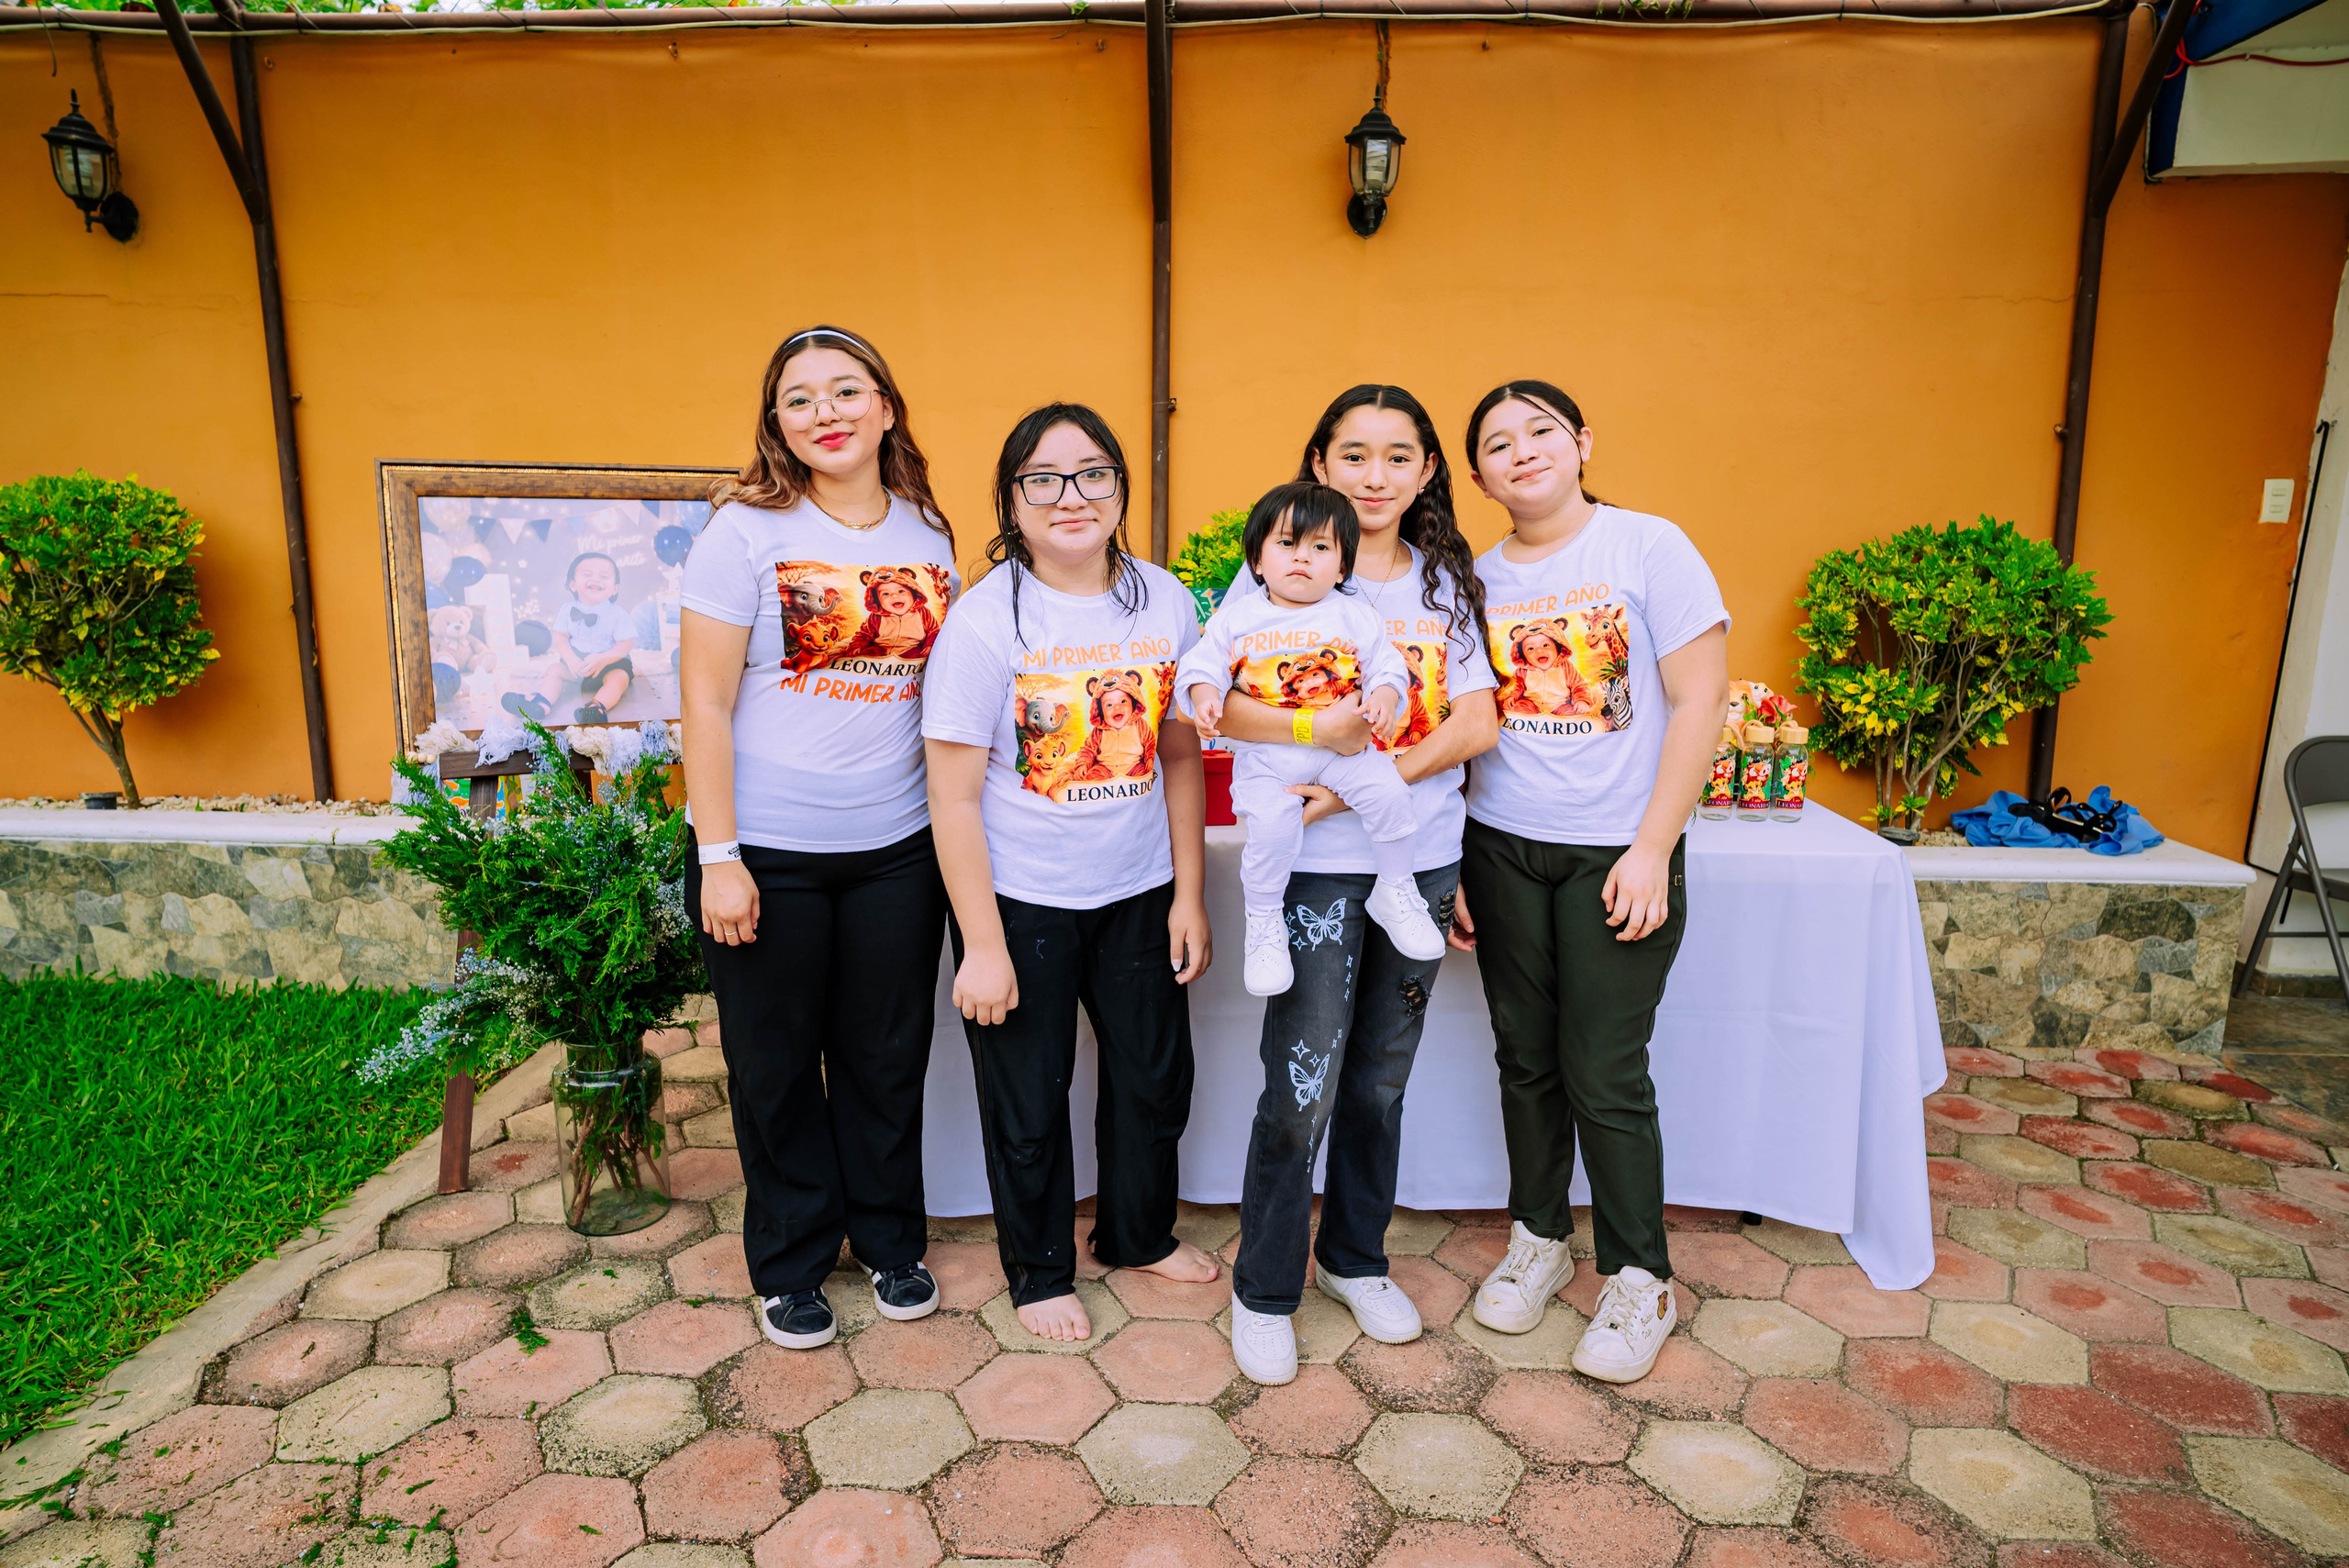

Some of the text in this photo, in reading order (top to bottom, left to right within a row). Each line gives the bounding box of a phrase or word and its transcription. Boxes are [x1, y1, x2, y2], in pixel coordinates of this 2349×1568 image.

[1486, 583, 1609, 616] PRIMER AÑO
[1023, 635, 1171, 668] MI PRIMER AÑO
[1242, 630, 1321, 654] PRIMER
[780, 673, 808, 694] MI
[813, 676, 896, 704] PRIMER
[1067, 778, 1153, 802] LEONARDO
